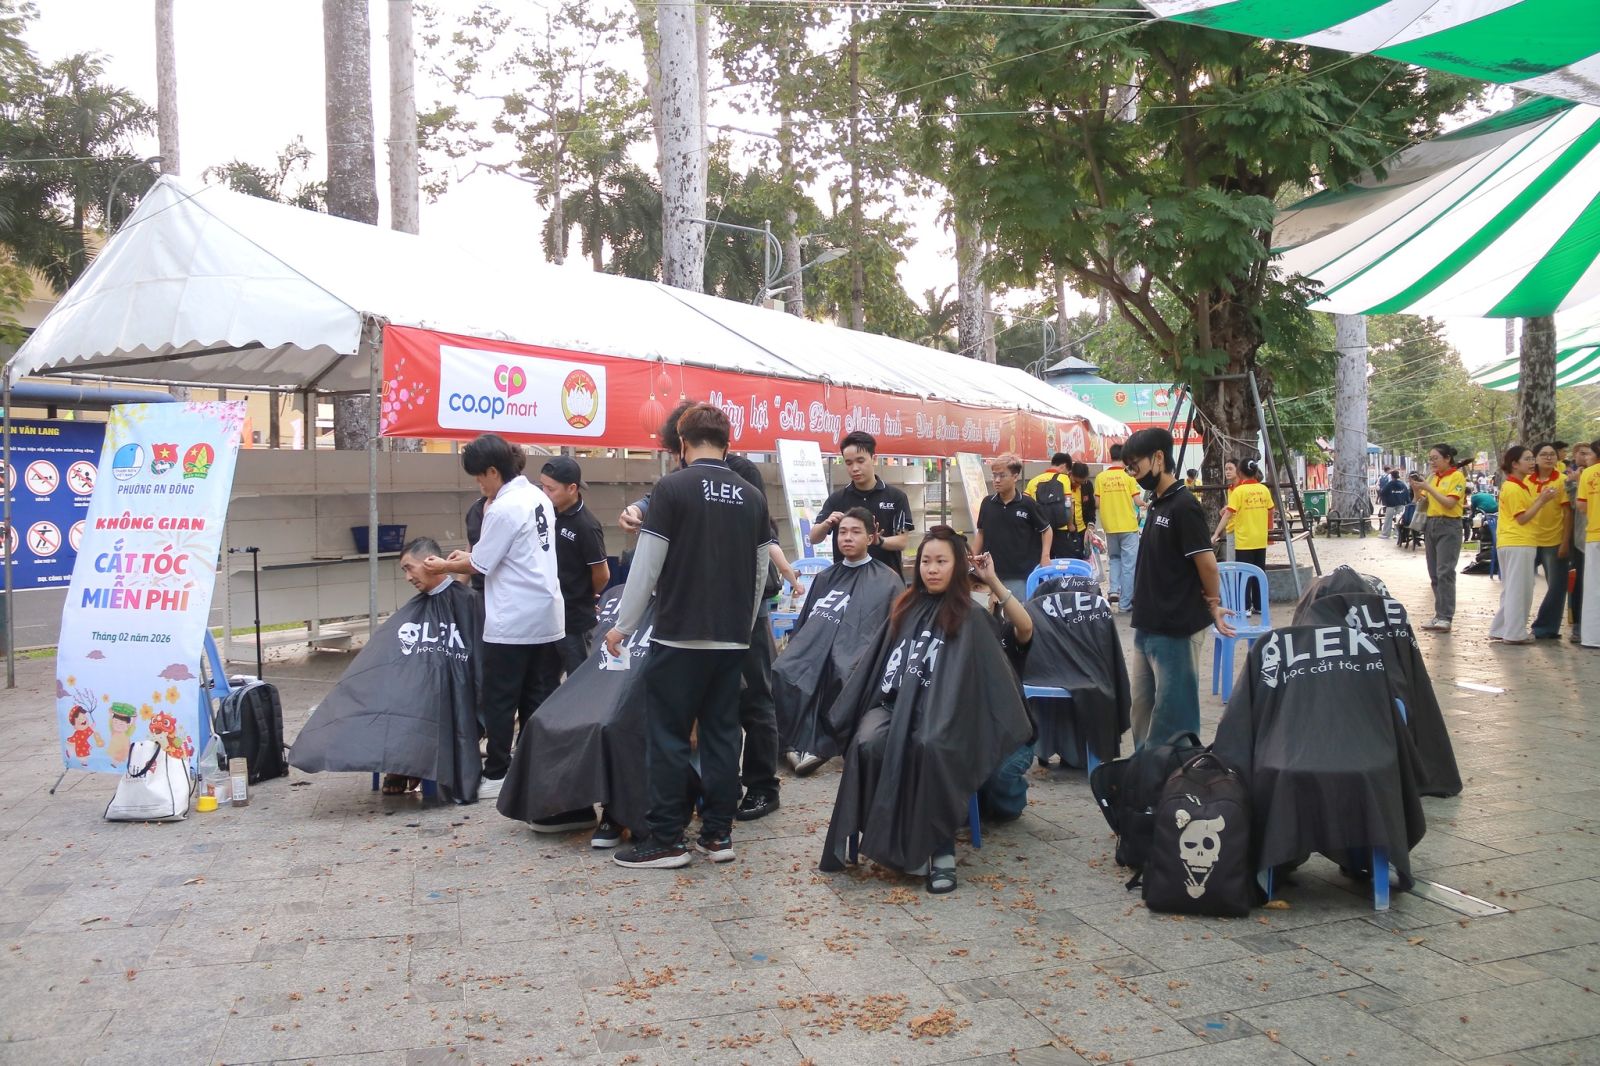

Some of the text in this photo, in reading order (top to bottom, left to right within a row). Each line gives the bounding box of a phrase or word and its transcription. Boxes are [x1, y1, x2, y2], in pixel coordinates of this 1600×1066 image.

[506, 401, 538, 417] mart
[38, 427, 60, 436] LANG
[153, 484, 167, 494] AN
[710, 481, 744, 501] LEK
[95, 511, 205, 530] KHÔNG GIAN
[94, 538, 189, 575] CẮT TÓC
[81, 574, 194, 611] MIỄN PHÍ
[92, 631, 117, 643] Tháng
[118, 632, 129, 641] 02
[150, 633, 171, 643] 2026
[1284, 626, 1381, 668] LEK
[1283, 667, 1306, 684] học
[1310, 660, 1334, 675] cắt
[1339, 660, 1361, 672] tóc
